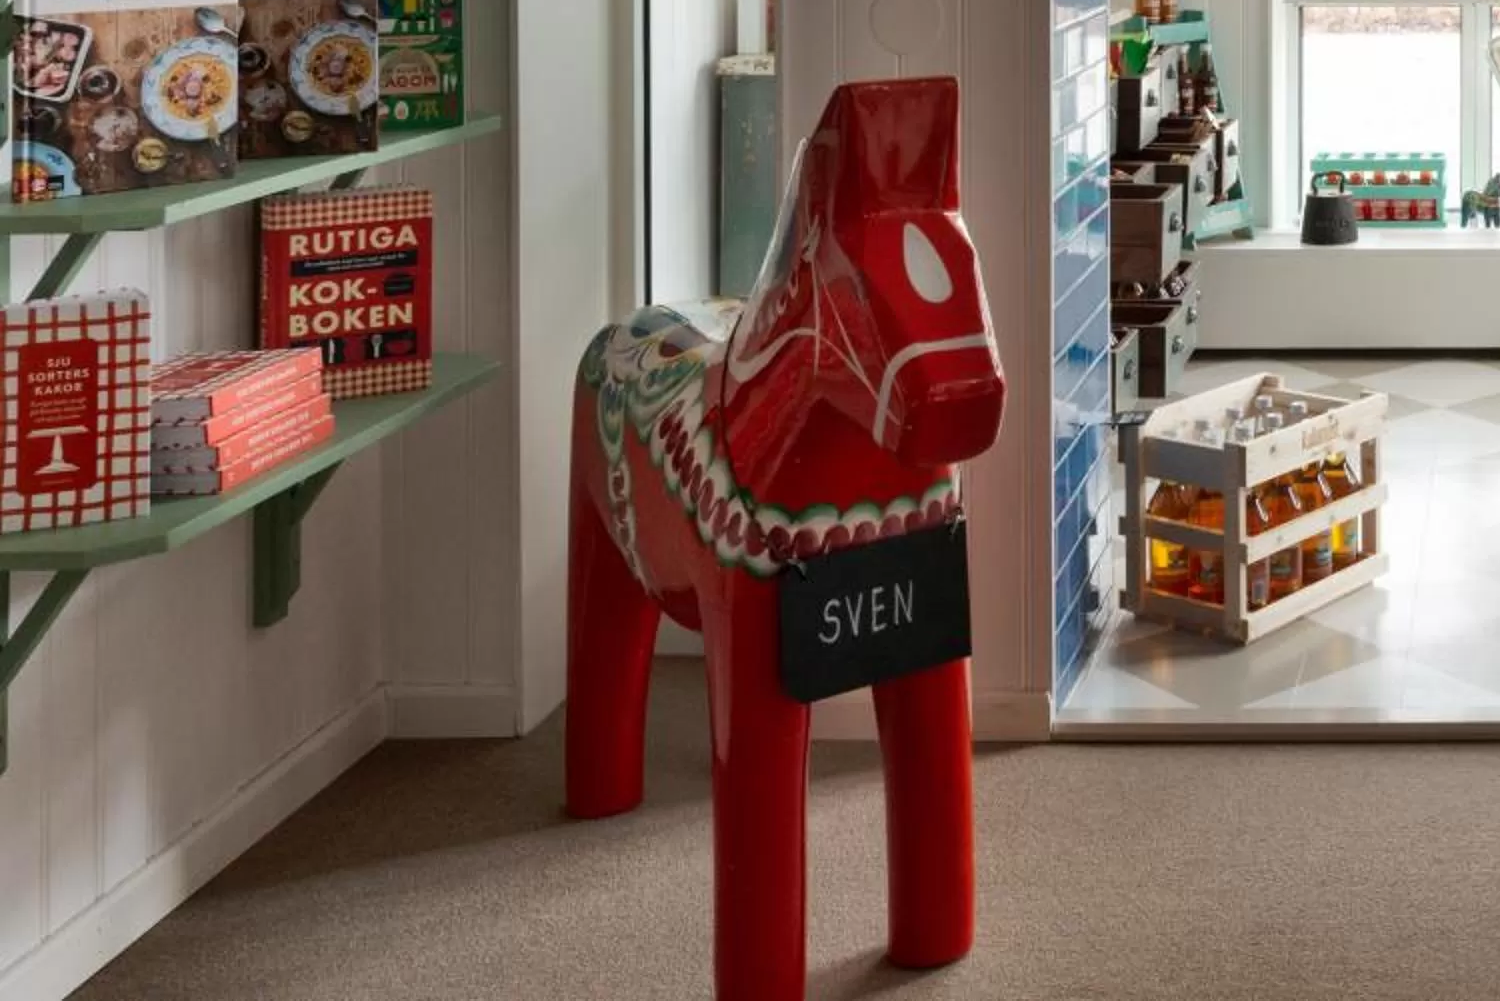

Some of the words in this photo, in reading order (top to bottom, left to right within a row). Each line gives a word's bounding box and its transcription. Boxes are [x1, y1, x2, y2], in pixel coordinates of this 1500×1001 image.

[383, 74, 437, 88] AGOM
[289, 225, 418, 256] RUTIGA
[289, 277, 377, 308] KOK-
[289, 302, 413, 337] BOKEN
[47, 357, 71, 368] SJU
[818, 579, 914, 644] SVEN
